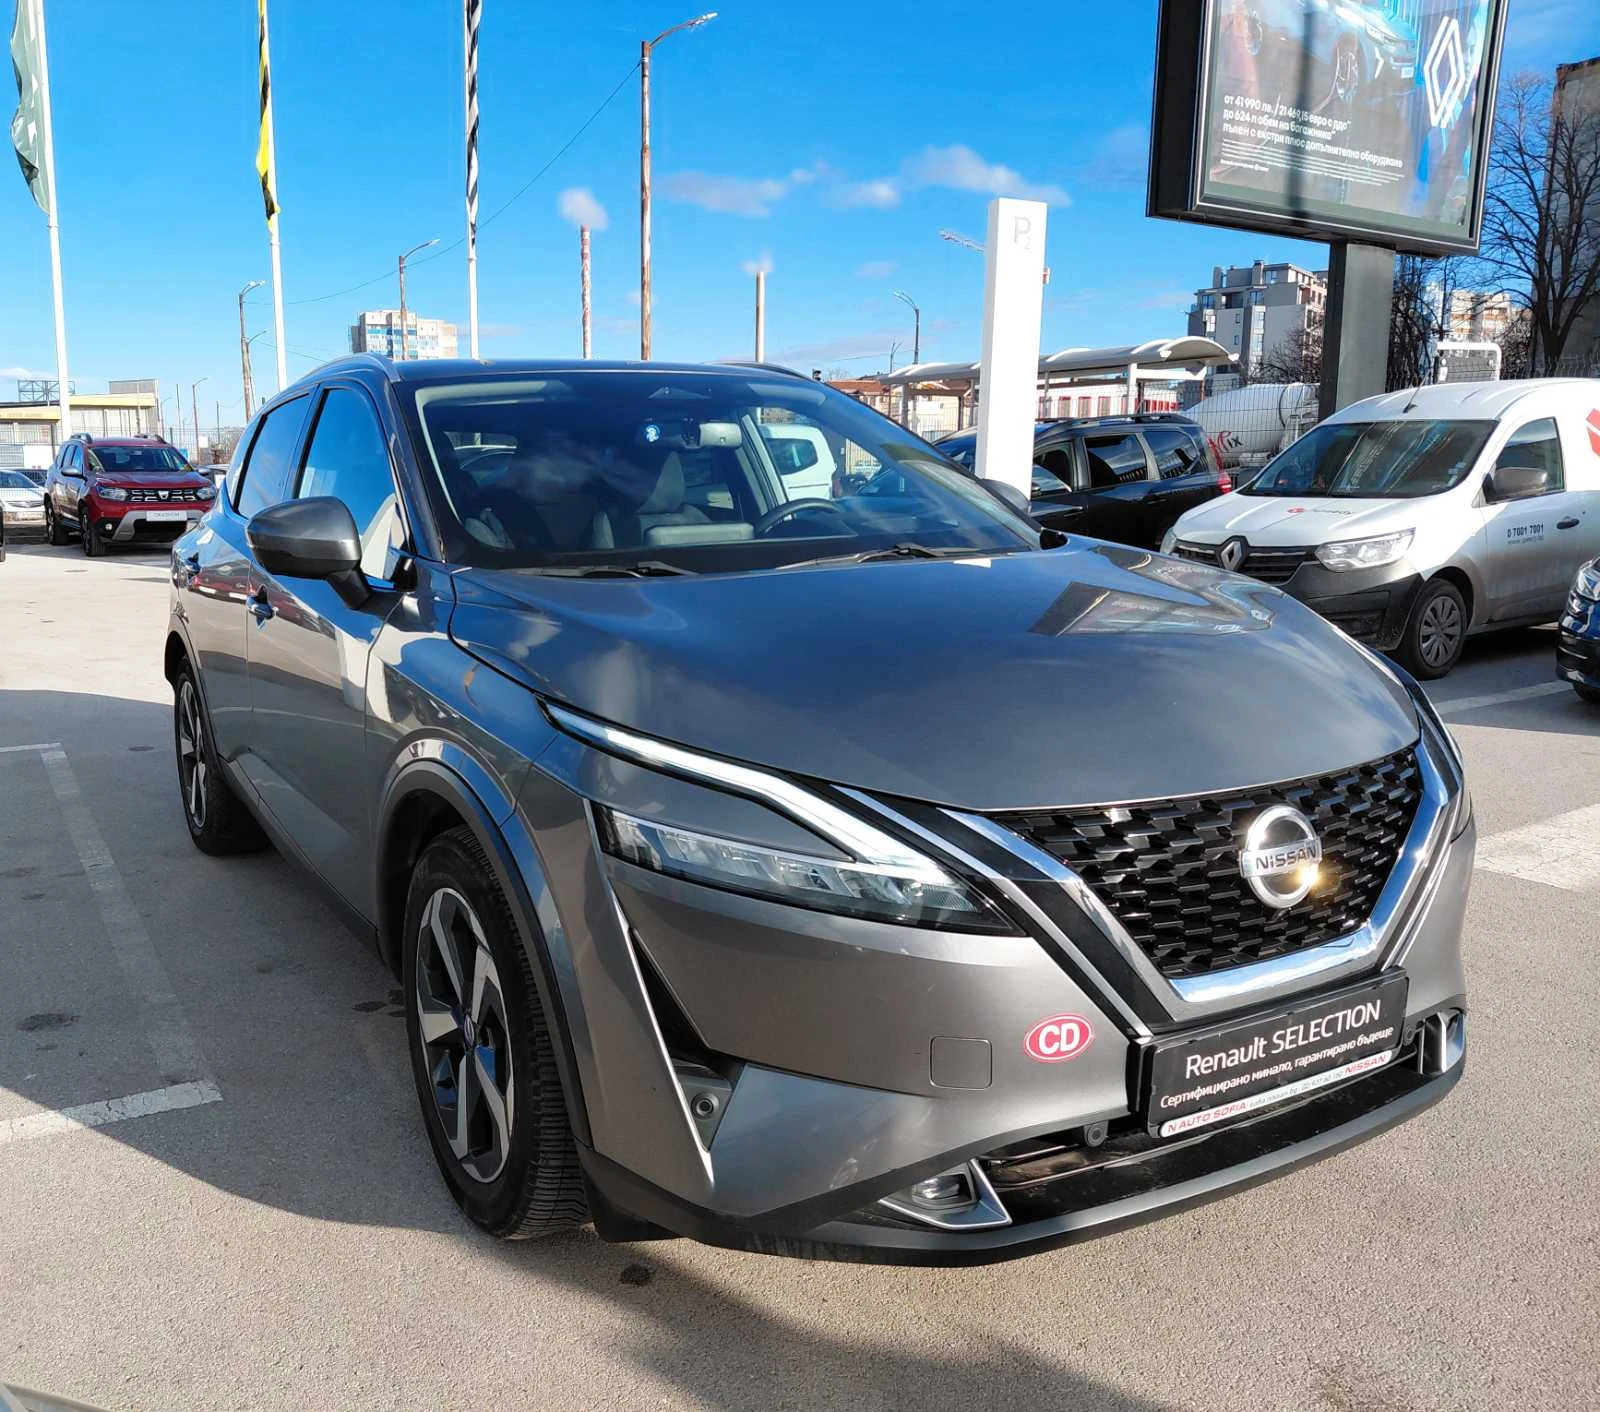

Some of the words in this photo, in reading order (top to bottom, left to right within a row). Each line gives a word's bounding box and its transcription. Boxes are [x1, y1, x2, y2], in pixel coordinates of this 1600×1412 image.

[1224, 95, 1234, 104] от
[1244, 98, 1261, 110] 990
[1309, 114, 1327, 127] евро
[1234, 111, 1251, 122] 624
[1256, 847, 1317, 870] NISSAN
[1038, 1022, 1080, 1055] CD
[1185, 1036, 1268, 1079] Renault
[1271, 999, 1381, 1054] SELECTION
[1160, 1073, 1250, 1109] Сертифицирано
[1251, 1061, 1293, 1083] минало,
[1294, 1040, 1357, 1068] гарантирано
[1357, 1027, 1394, 1047] бъдеще
[1167, 1123, 1178, 1133] N
[1179, 1112, 1211, 1130] AUTO
[1213, 1101, 1248, 1118] SOFIA
[1343, 1054, 1388, 1075] NISSAN
